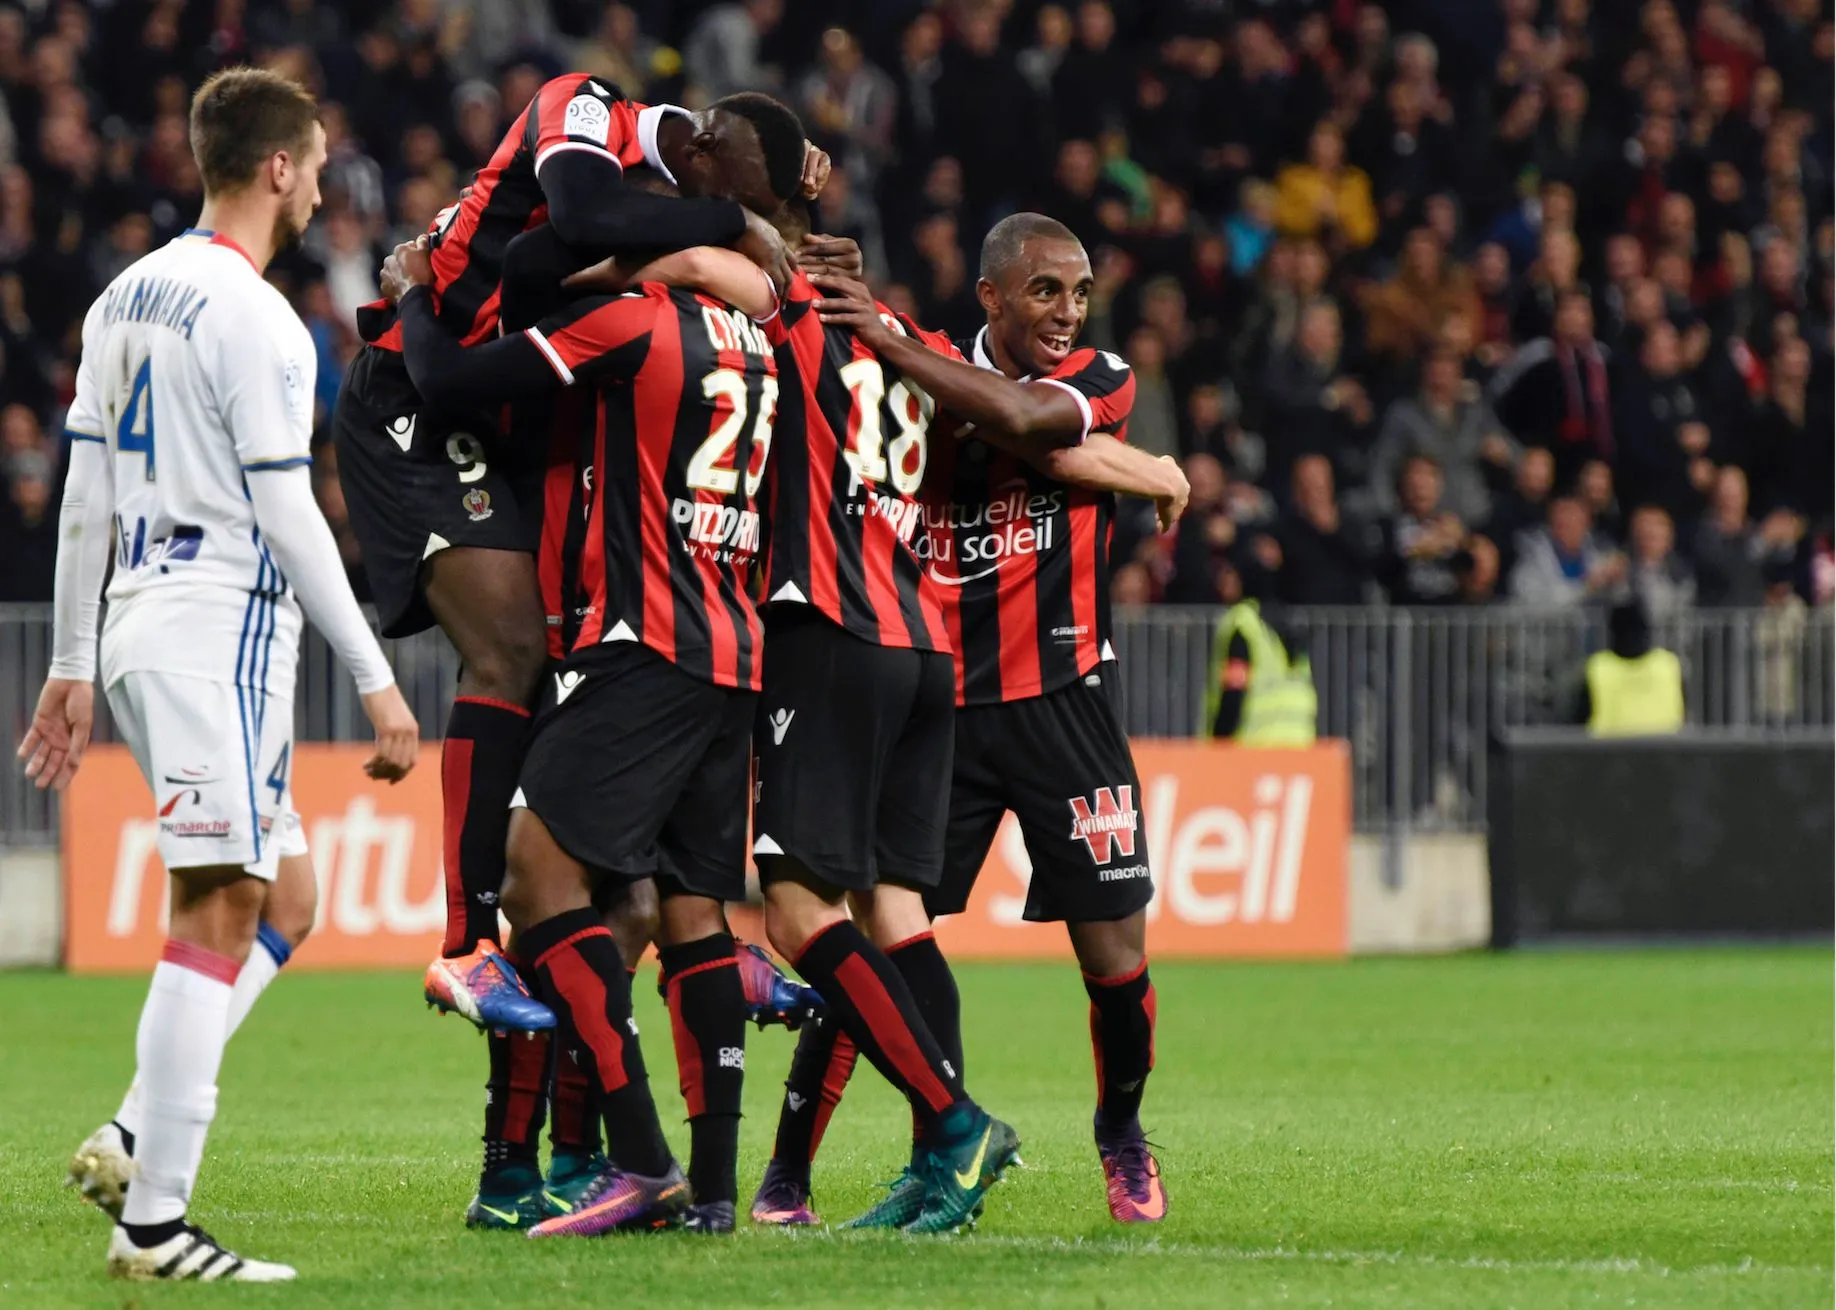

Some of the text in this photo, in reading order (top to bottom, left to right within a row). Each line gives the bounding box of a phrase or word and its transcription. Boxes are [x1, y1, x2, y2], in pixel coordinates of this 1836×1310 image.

[117, 354, 156, 483] 4
[446, 432, 487, 483] 9
[687, 368, 779, 497] 25
[840, 358, 936, 495] 18
[915, 516, 1053, 562] du soleil
[265, 740, 289, 806] 4
[986, 775, 1314, 926] sleil
[1100, 864, 1149, 881] macron
